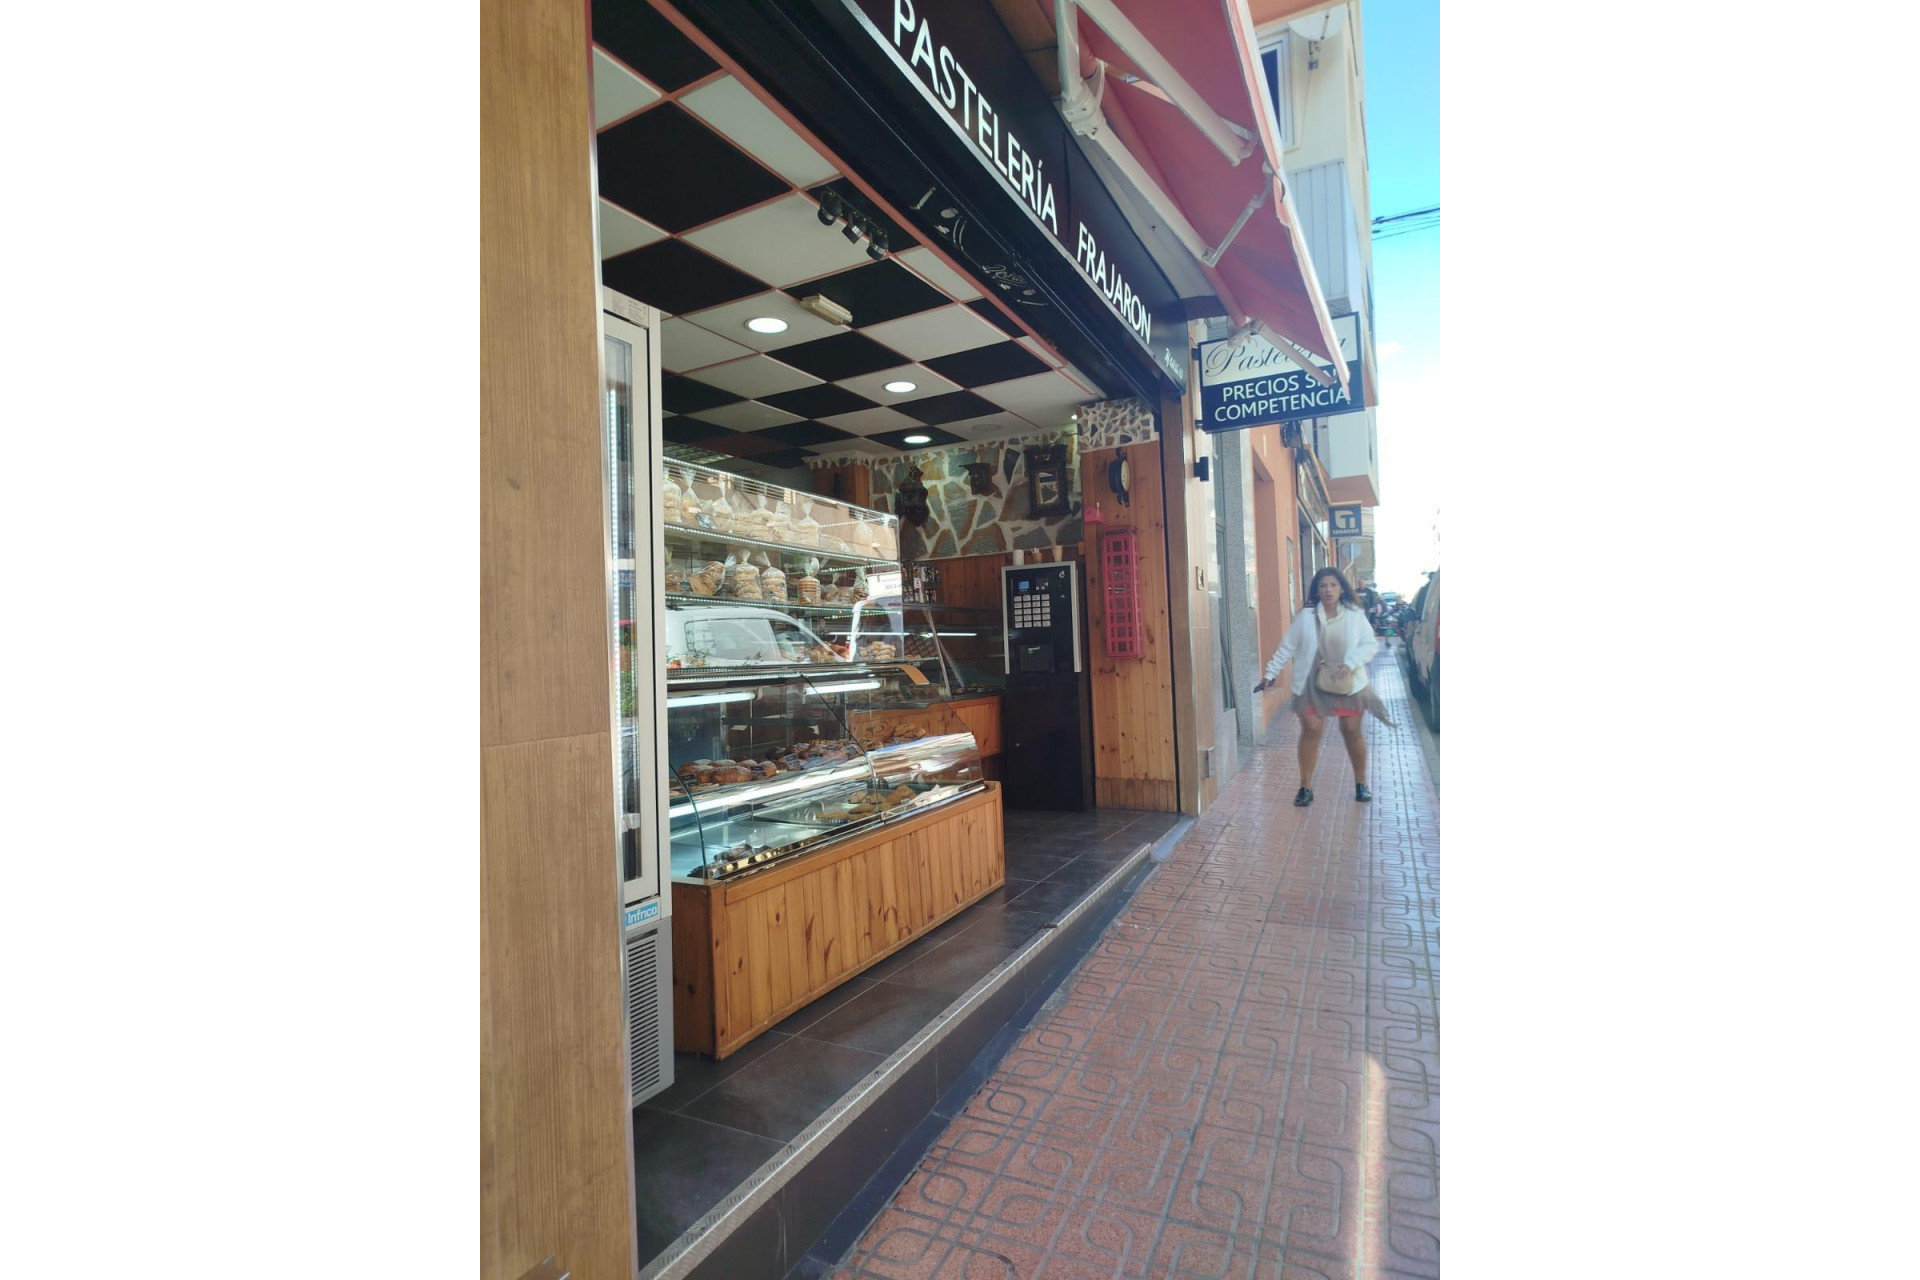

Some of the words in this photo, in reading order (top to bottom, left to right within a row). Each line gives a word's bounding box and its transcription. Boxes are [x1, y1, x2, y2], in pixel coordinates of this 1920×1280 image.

[894, 0, 1058, 236] PASTELERÍA
[1077, 221, 1151, 345] FRAJARON
[1214, 387, 1350, 422] COMPETENCIA
[1222, 374, 1300, 402] PRECIOS
